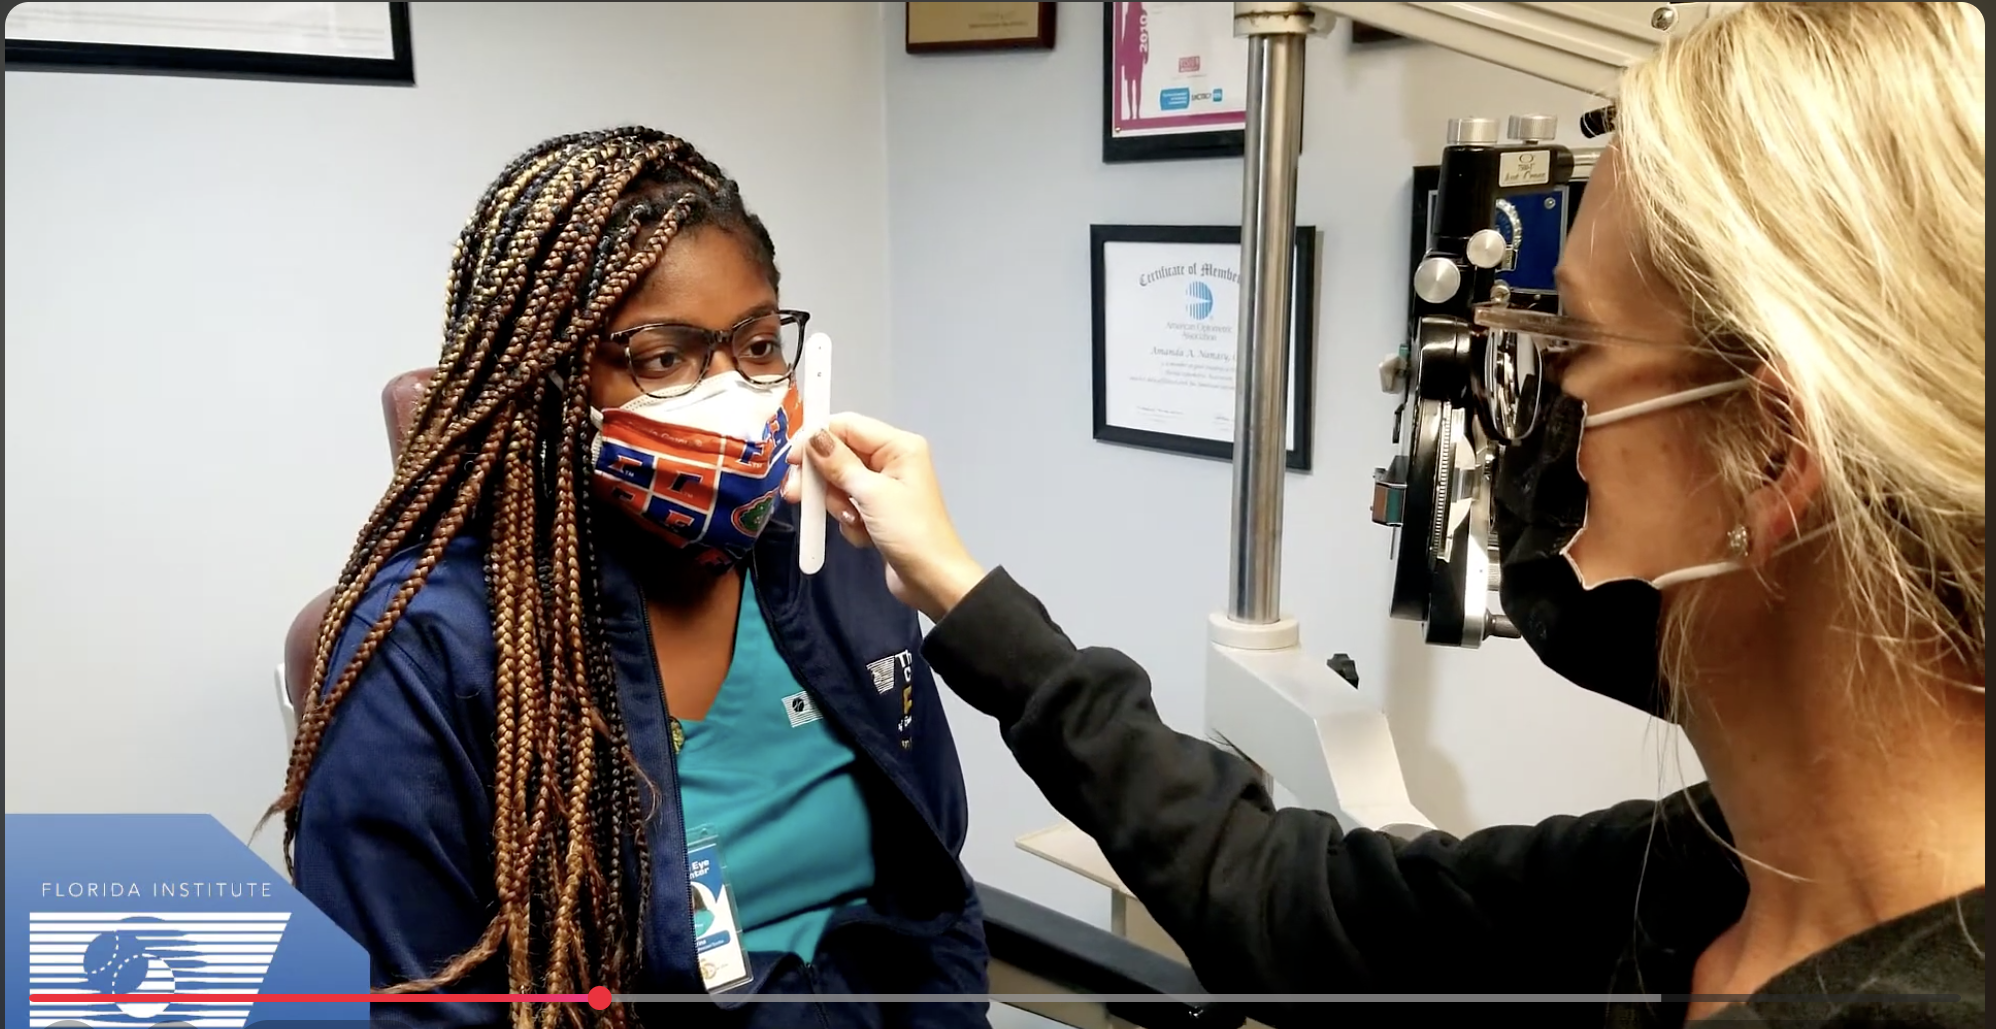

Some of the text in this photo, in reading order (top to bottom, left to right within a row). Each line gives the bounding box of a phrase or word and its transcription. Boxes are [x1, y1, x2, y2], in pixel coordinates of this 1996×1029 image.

[1139, 14, 1148, 53] 2010
[1139, 265, 1185, 287] Certificate
[1188, 262, 1197, 275] of
[691, 859, 710, 872] Eye
